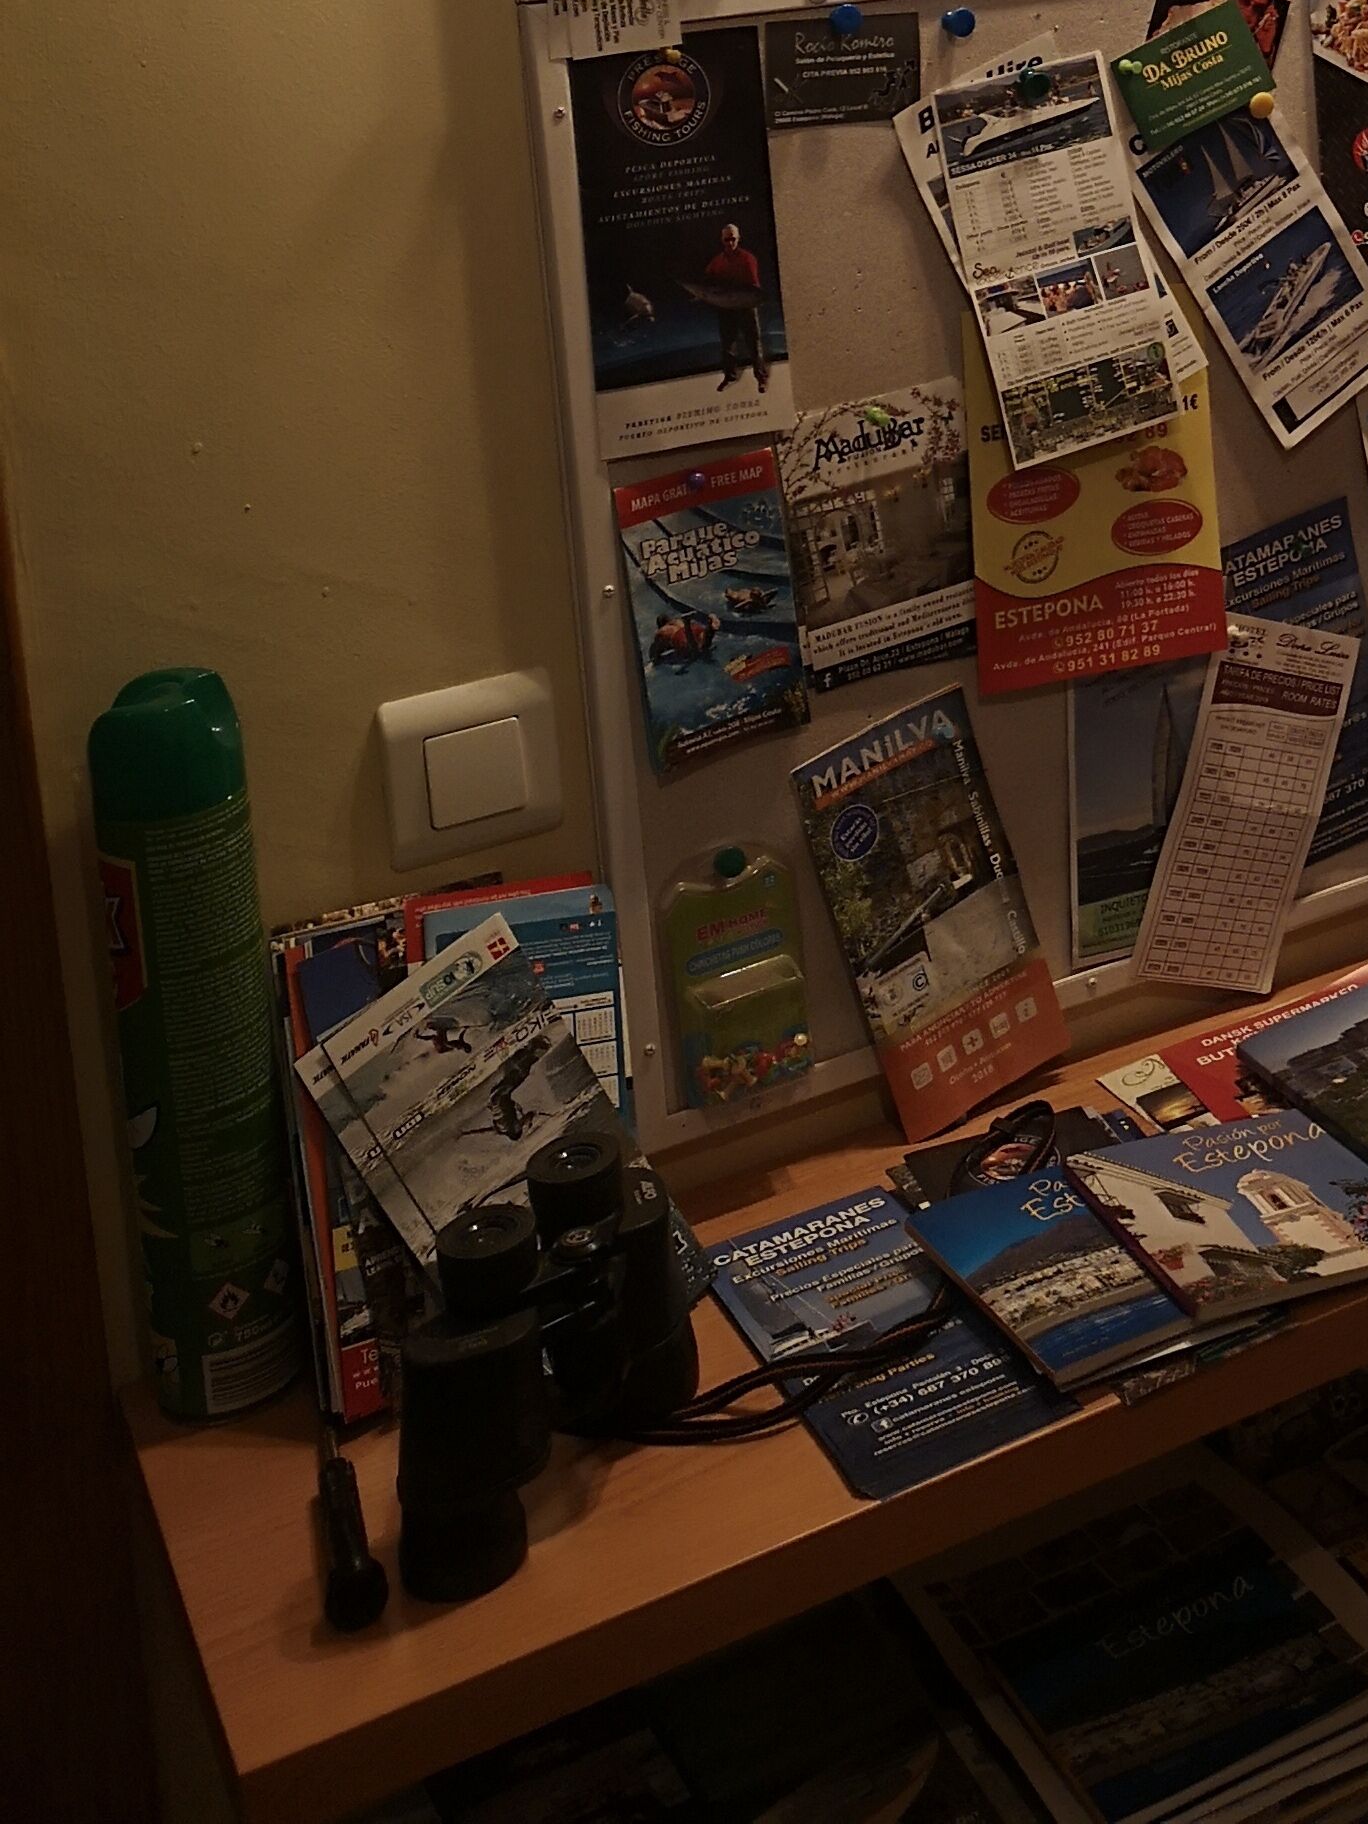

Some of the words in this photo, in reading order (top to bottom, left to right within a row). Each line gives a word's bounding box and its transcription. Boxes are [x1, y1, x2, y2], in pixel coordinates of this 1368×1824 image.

[628, 52, 697, 82] PRESGE
[1170, 31, 1229, 69] BRUNO
[1160, 69, 1194, 92] Mijas
[1192, 53, 1225, 74] Costa
[623, 110, 672, 143] FISHING
[675, 100, 707, 139] TOURS
[1262, 365, 1281, 382] From
[631, 492, 661, 513] MAPA
[710, 470, 737, 489] FREE
[739, 466, 764, 482] MAP
[641, 522, 728, 556] Parque
[647, 530, 760, 576] Acuático
[1225, 514, 1343, 575] ATAMARANES
[668, 552, 738, 585] Mijas
[994, 594, 1104, 630] ESTEPONA
[1066, 632, 1092, 646] 952
[1067, 658, 1094, 673] 951
[1099, 653, 1115, 667] 31
[1121, 649, 1139, 662] 82
[1143, 644, 1161, 659] 89
[1281, 689, 1308, 704] ROOM
[1309, 695, 1338, 710] RATES
[1300, 679, 1323, 692] PRICE
[1324, 682, 1341, 696] LIST
[811, 708, 959, 801] MANILVA
[951, 738, 972, 785] Manilva
[1200, 1022, 1252, 1049] DANSK
[1172, 1121, 1327, 1174] Estepona
[1182, 1120, 1256, 1153] Pasión
[1258, 1117, 1283, 1136] por
[712, 1196, 887, 1269] CATAMARANES
[744, 1213, 871, 1269] ESTEPONA
[731, 1245, 827, 1286] Excursiones
[774, 1252, 828, 1277] Sailing
[831, 1237, 868, 1260] Trips
[769, 1279, 820, 1303] Precios
[822, 1255, 881, 1283] Especiales
[815, 1267, 867, 1293] Familias
[888, 1351, 936, 1377] Parties
[872, 1393, 915, 1417] (+34)
[917, 1379, 946, 1401] 687
[949, 1367, 982, 1391] 370
